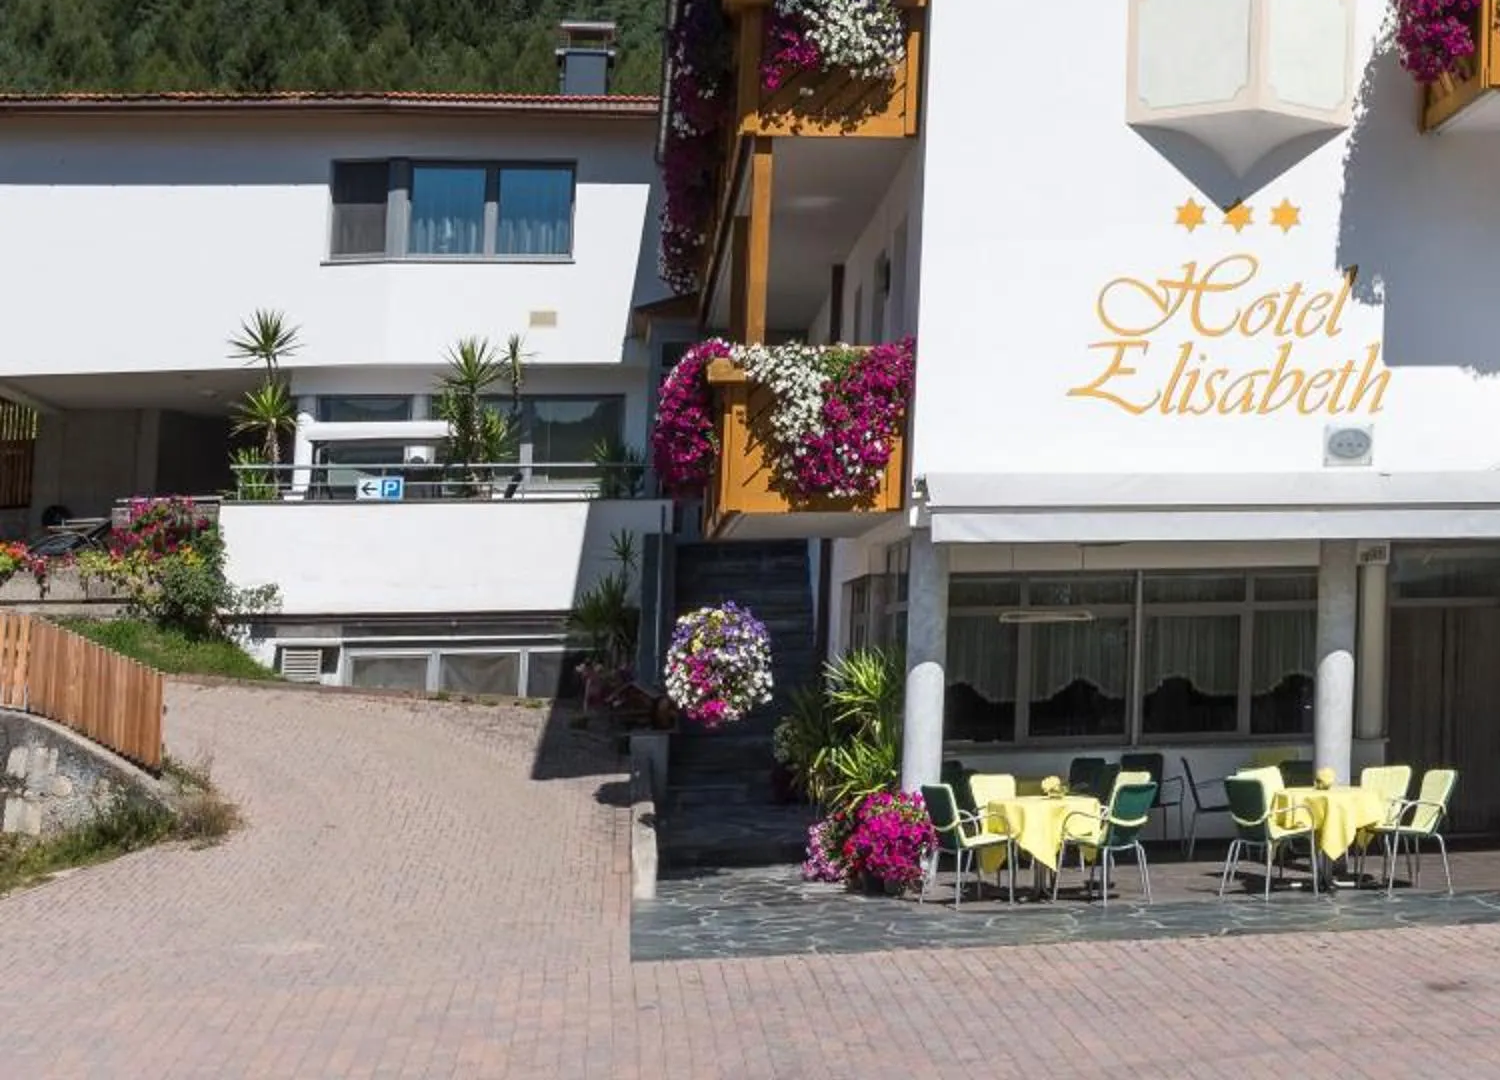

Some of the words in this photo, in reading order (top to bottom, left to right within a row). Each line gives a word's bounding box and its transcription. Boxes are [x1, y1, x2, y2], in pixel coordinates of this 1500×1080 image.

[1098, 253, 1358, 338] Hotel
[1066, 339, 1393, 416] Elisabeth
[384, 481, 398, 496] P
